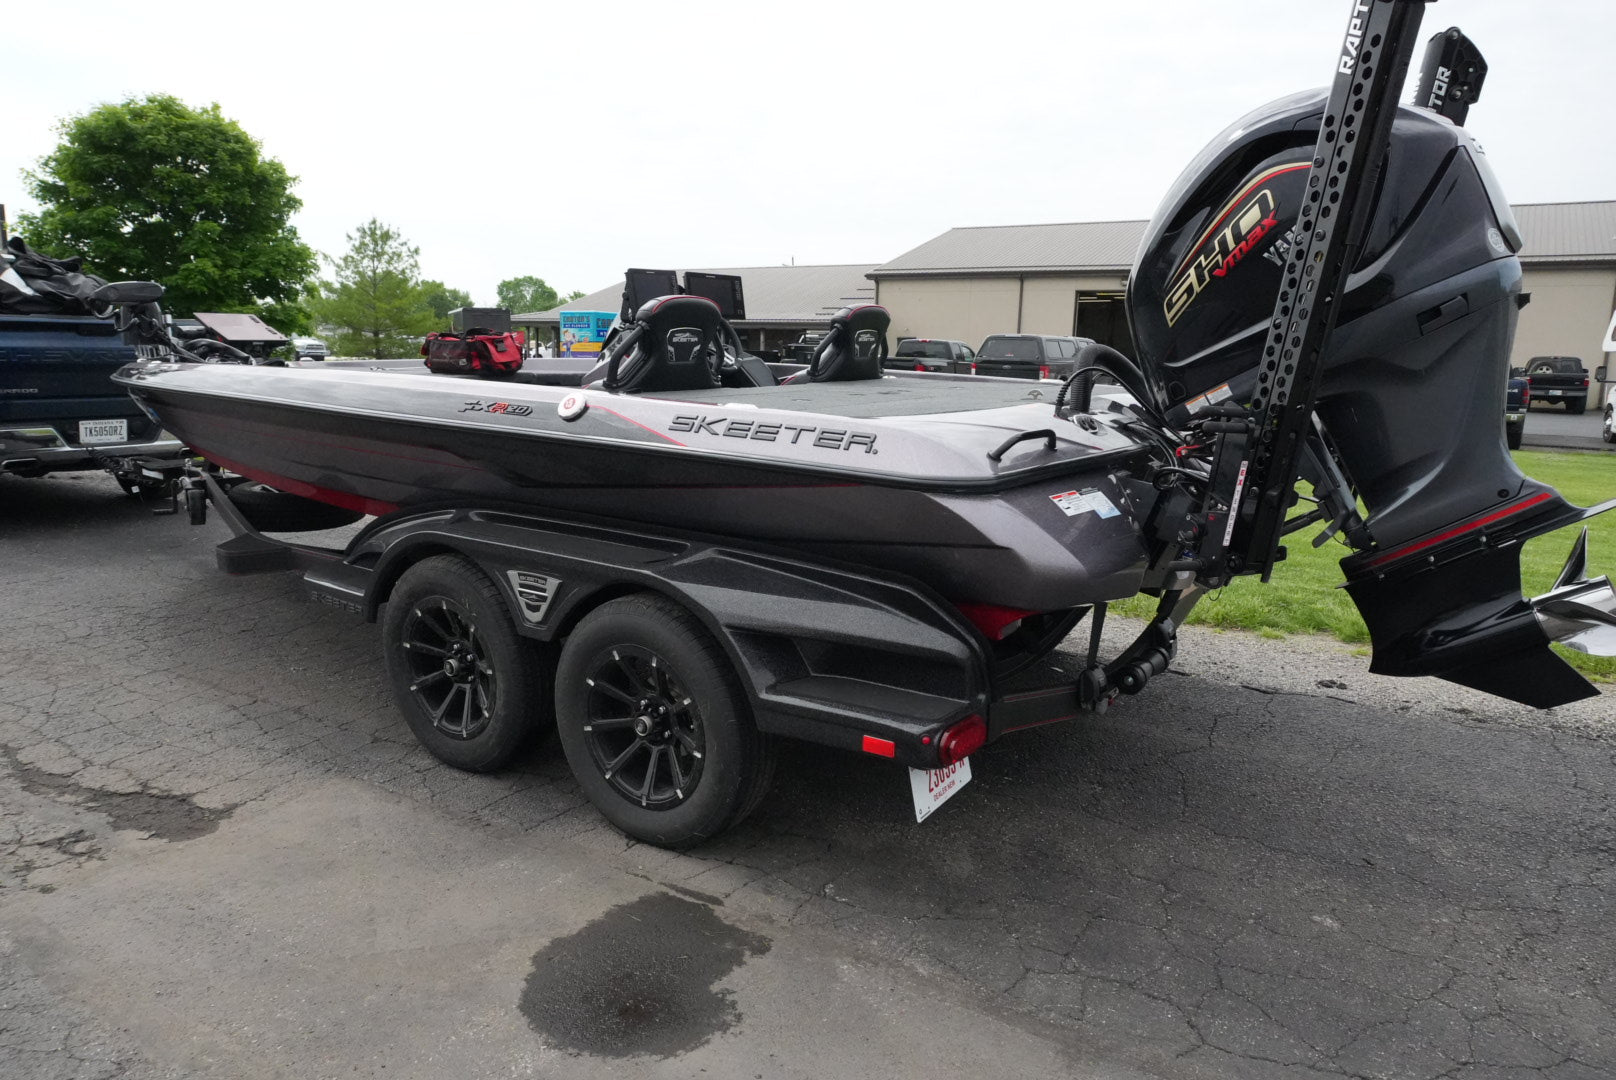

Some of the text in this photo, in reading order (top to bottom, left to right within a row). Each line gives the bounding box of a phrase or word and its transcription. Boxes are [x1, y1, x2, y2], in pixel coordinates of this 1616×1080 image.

[1427, 66, 1452, 113] TOR
[1163, 188, 1275, 328] SHO
[668, 413, 880, 455] SKEETER
